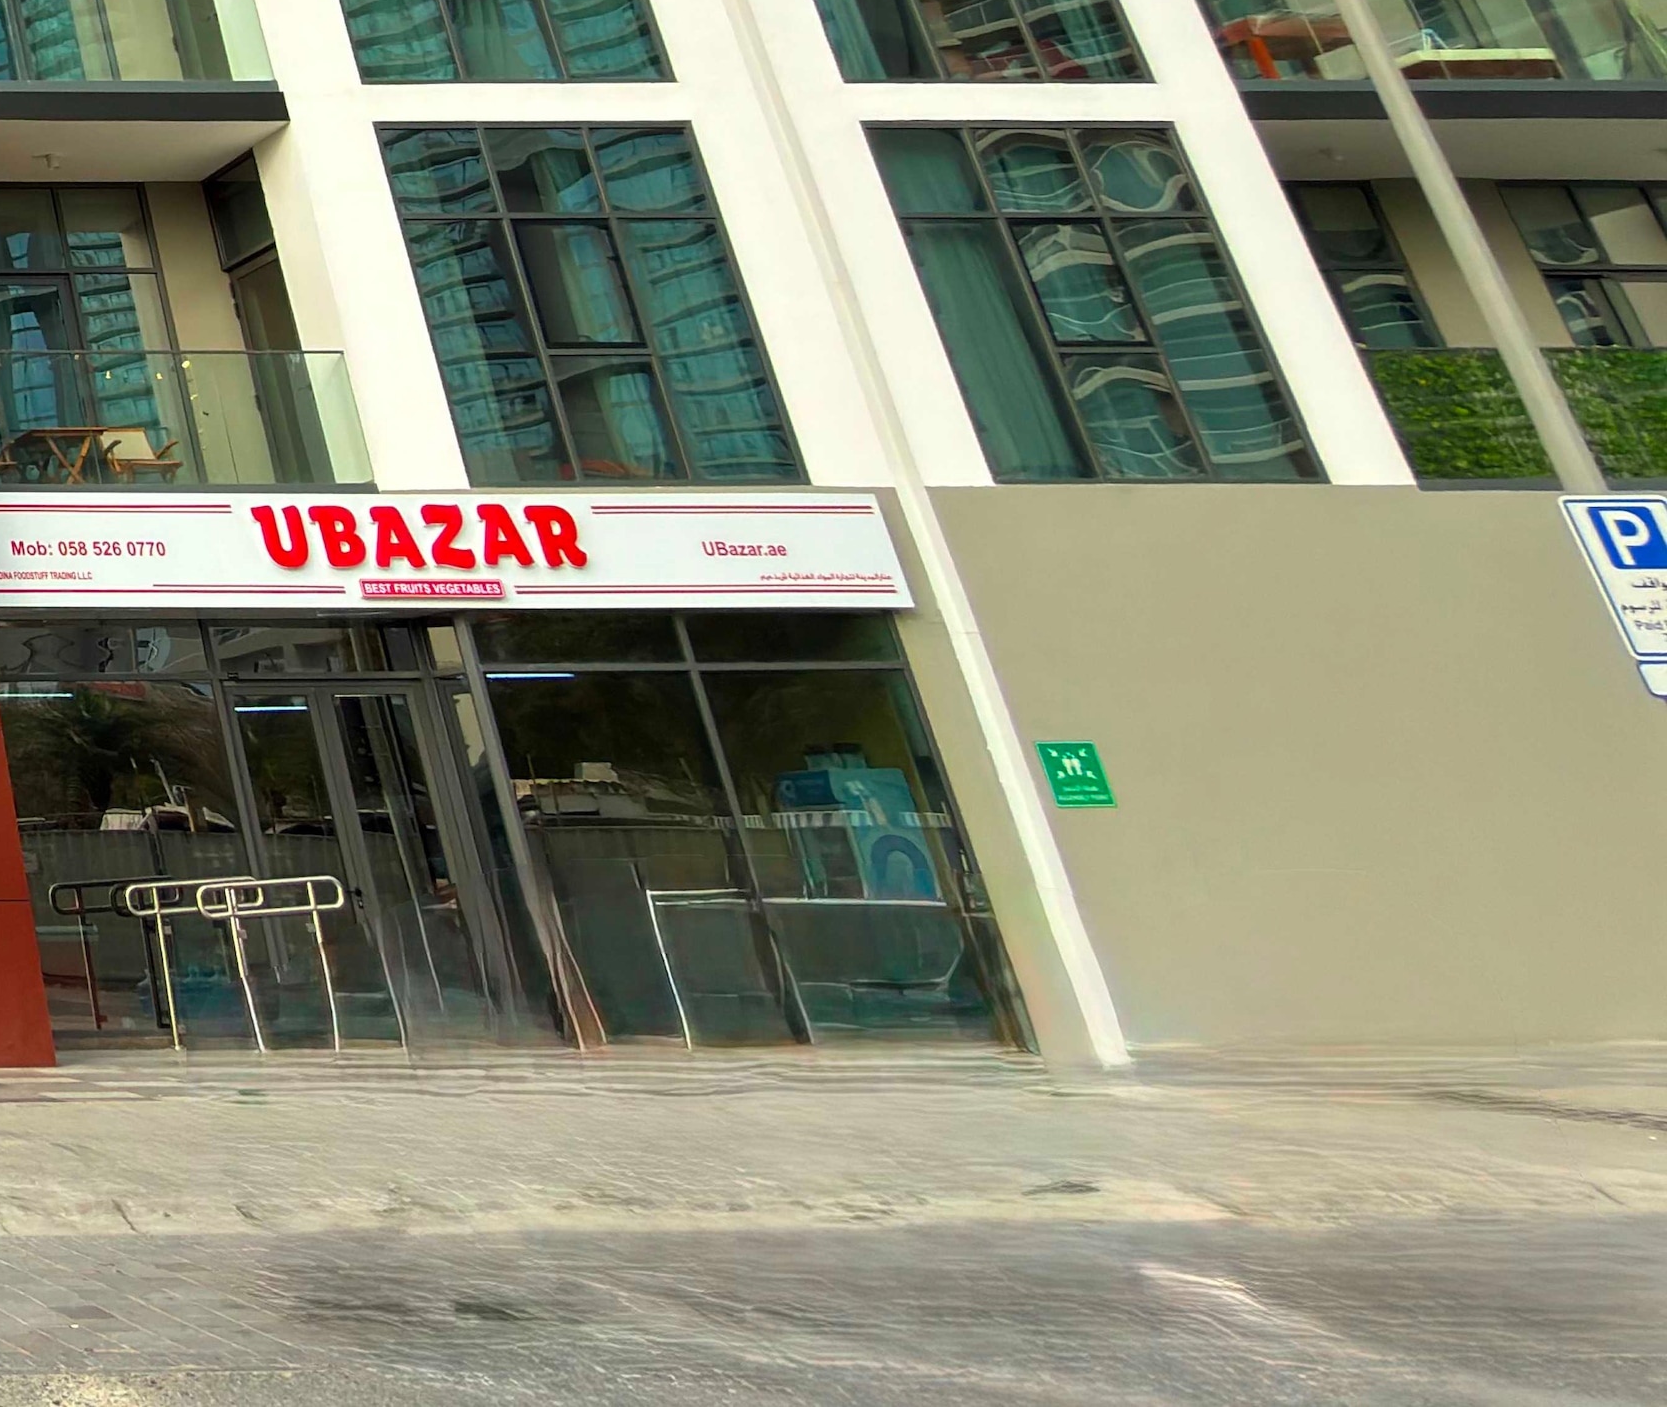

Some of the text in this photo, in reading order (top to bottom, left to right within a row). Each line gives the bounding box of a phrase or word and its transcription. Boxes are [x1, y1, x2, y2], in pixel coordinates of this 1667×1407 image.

[250, 503, 589, 570] UBAZAR
[1598, 510, 1651, 566] P
[10, 540, 166, 556] Mob: 058 526 0770
[701, 541, 788, 557] UBazar.ae
[365, 583, 501, 594] BEST FRUITS VEGETABLES
